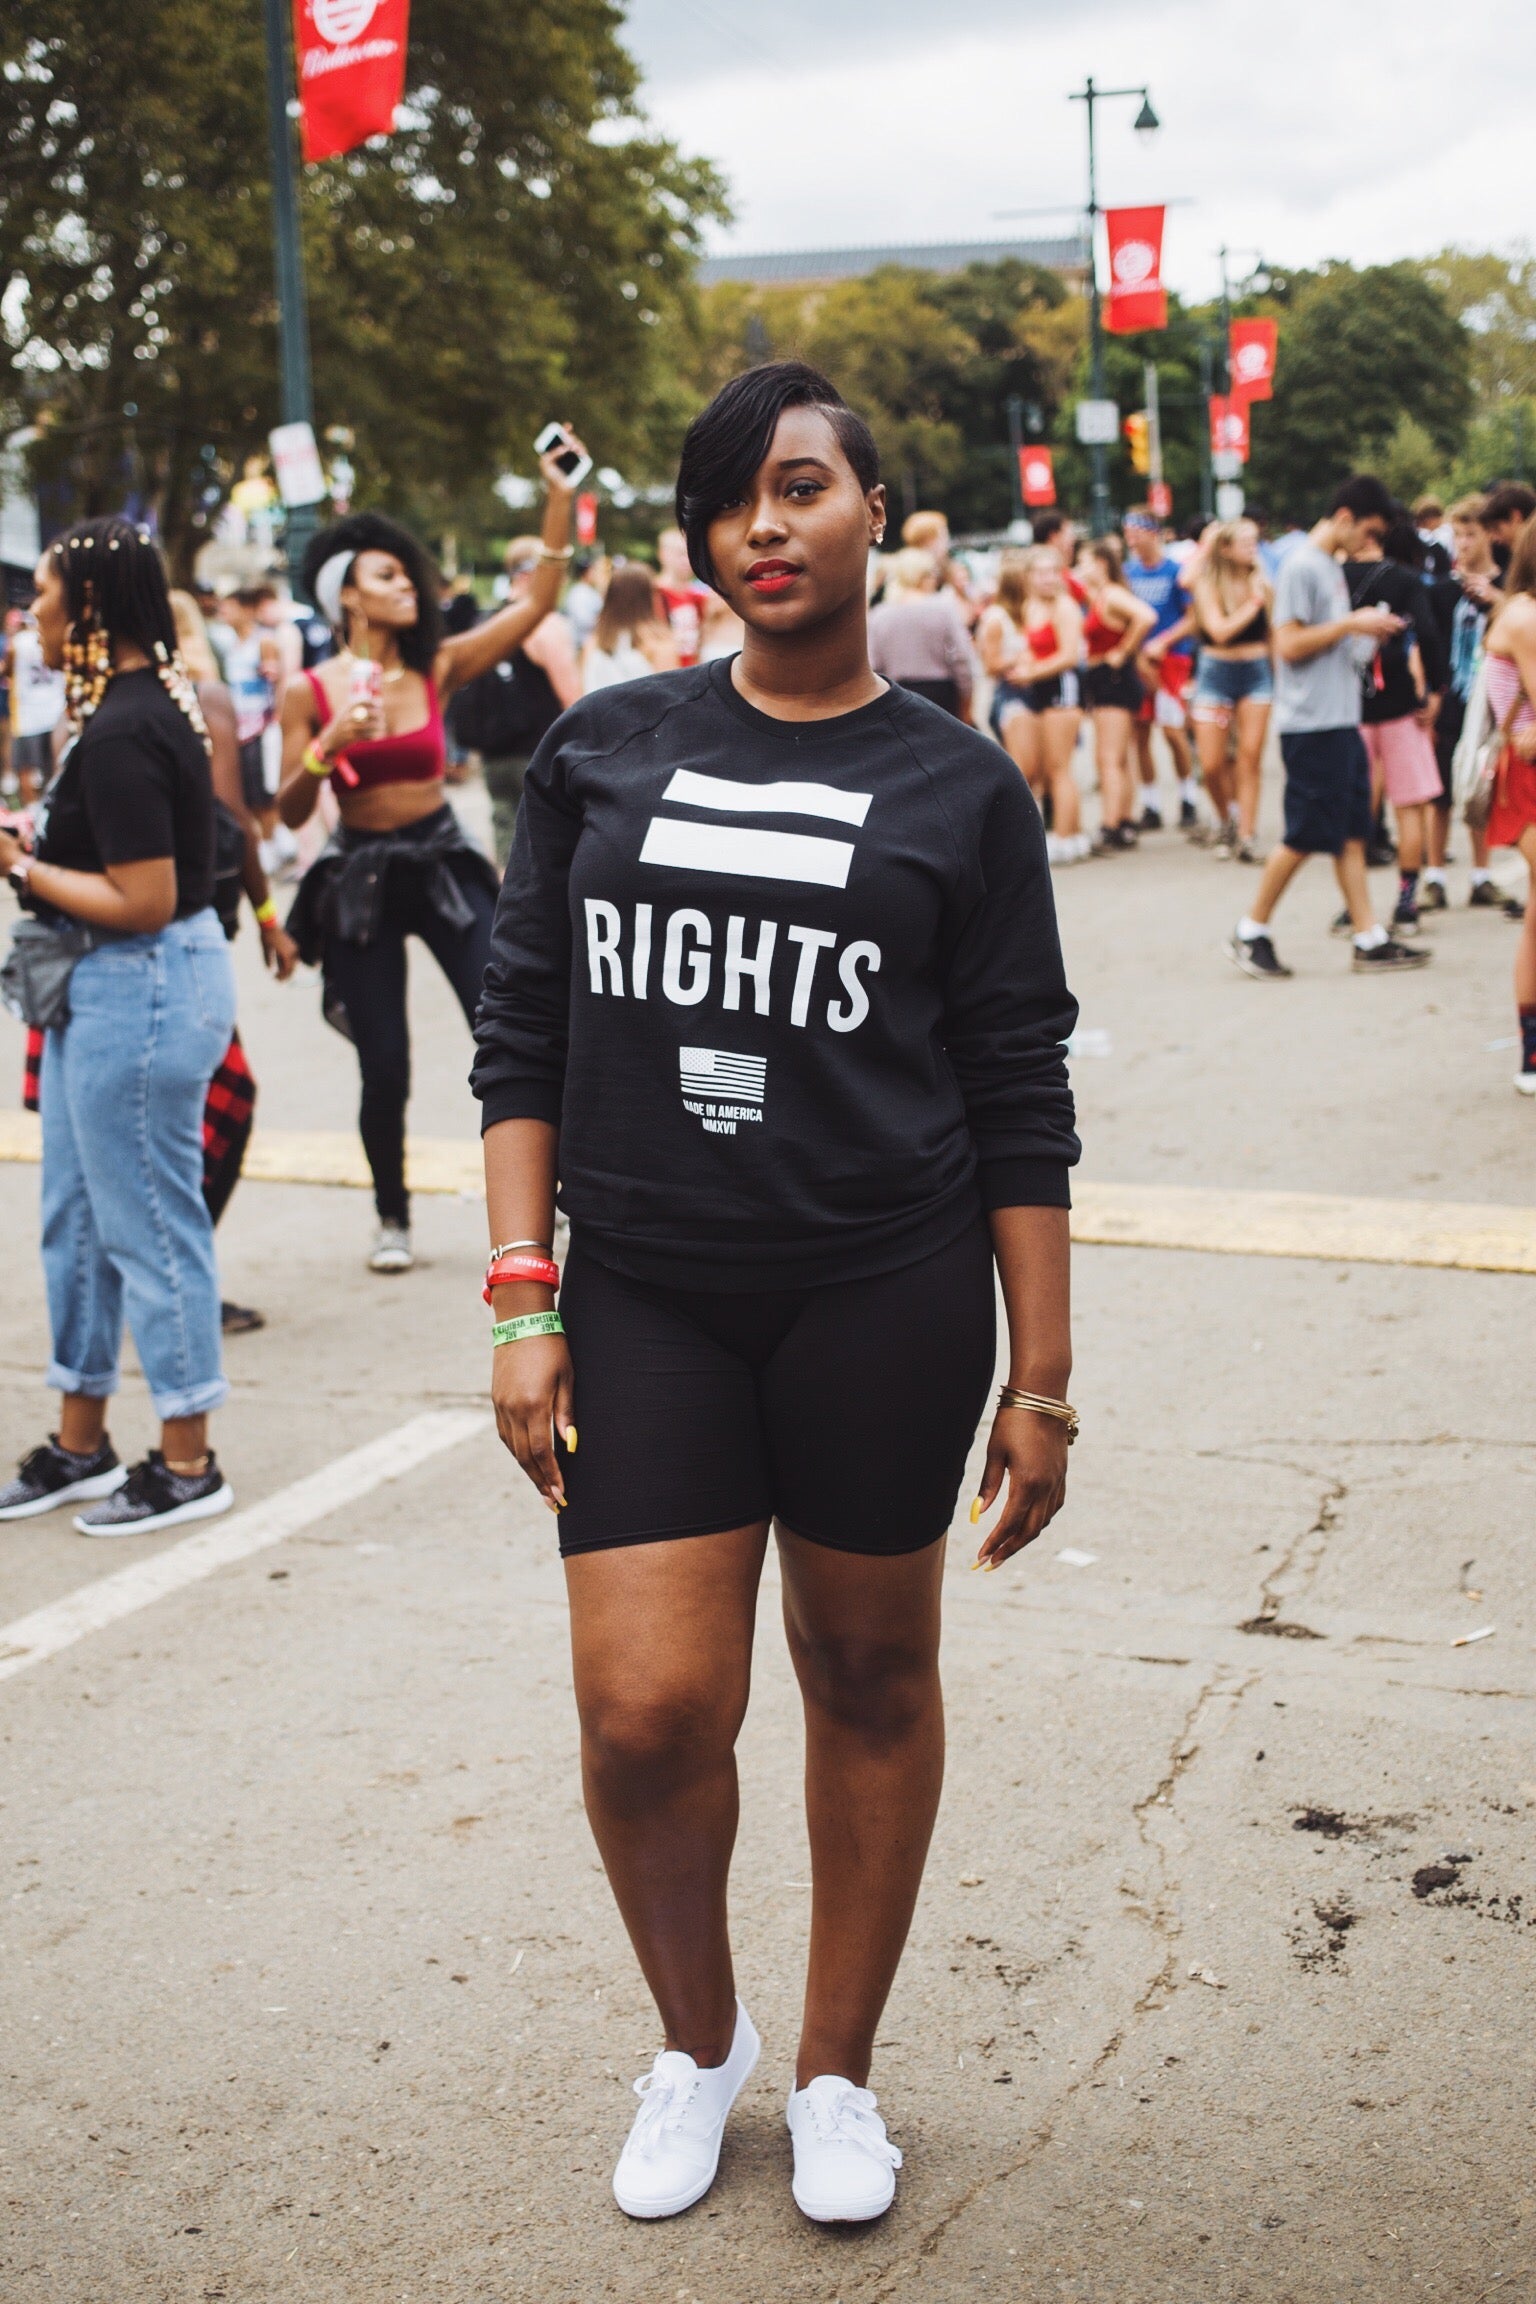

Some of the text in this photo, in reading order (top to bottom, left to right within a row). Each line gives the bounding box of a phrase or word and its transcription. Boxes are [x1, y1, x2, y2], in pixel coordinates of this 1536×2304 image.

[584, 898, 882, 1033] RIGHTS
[706, 1104, 717, 1118] IN
[718, 1105, 763, 1122] AMERICA
[702, 1118, 737, 1135] MMXVII
